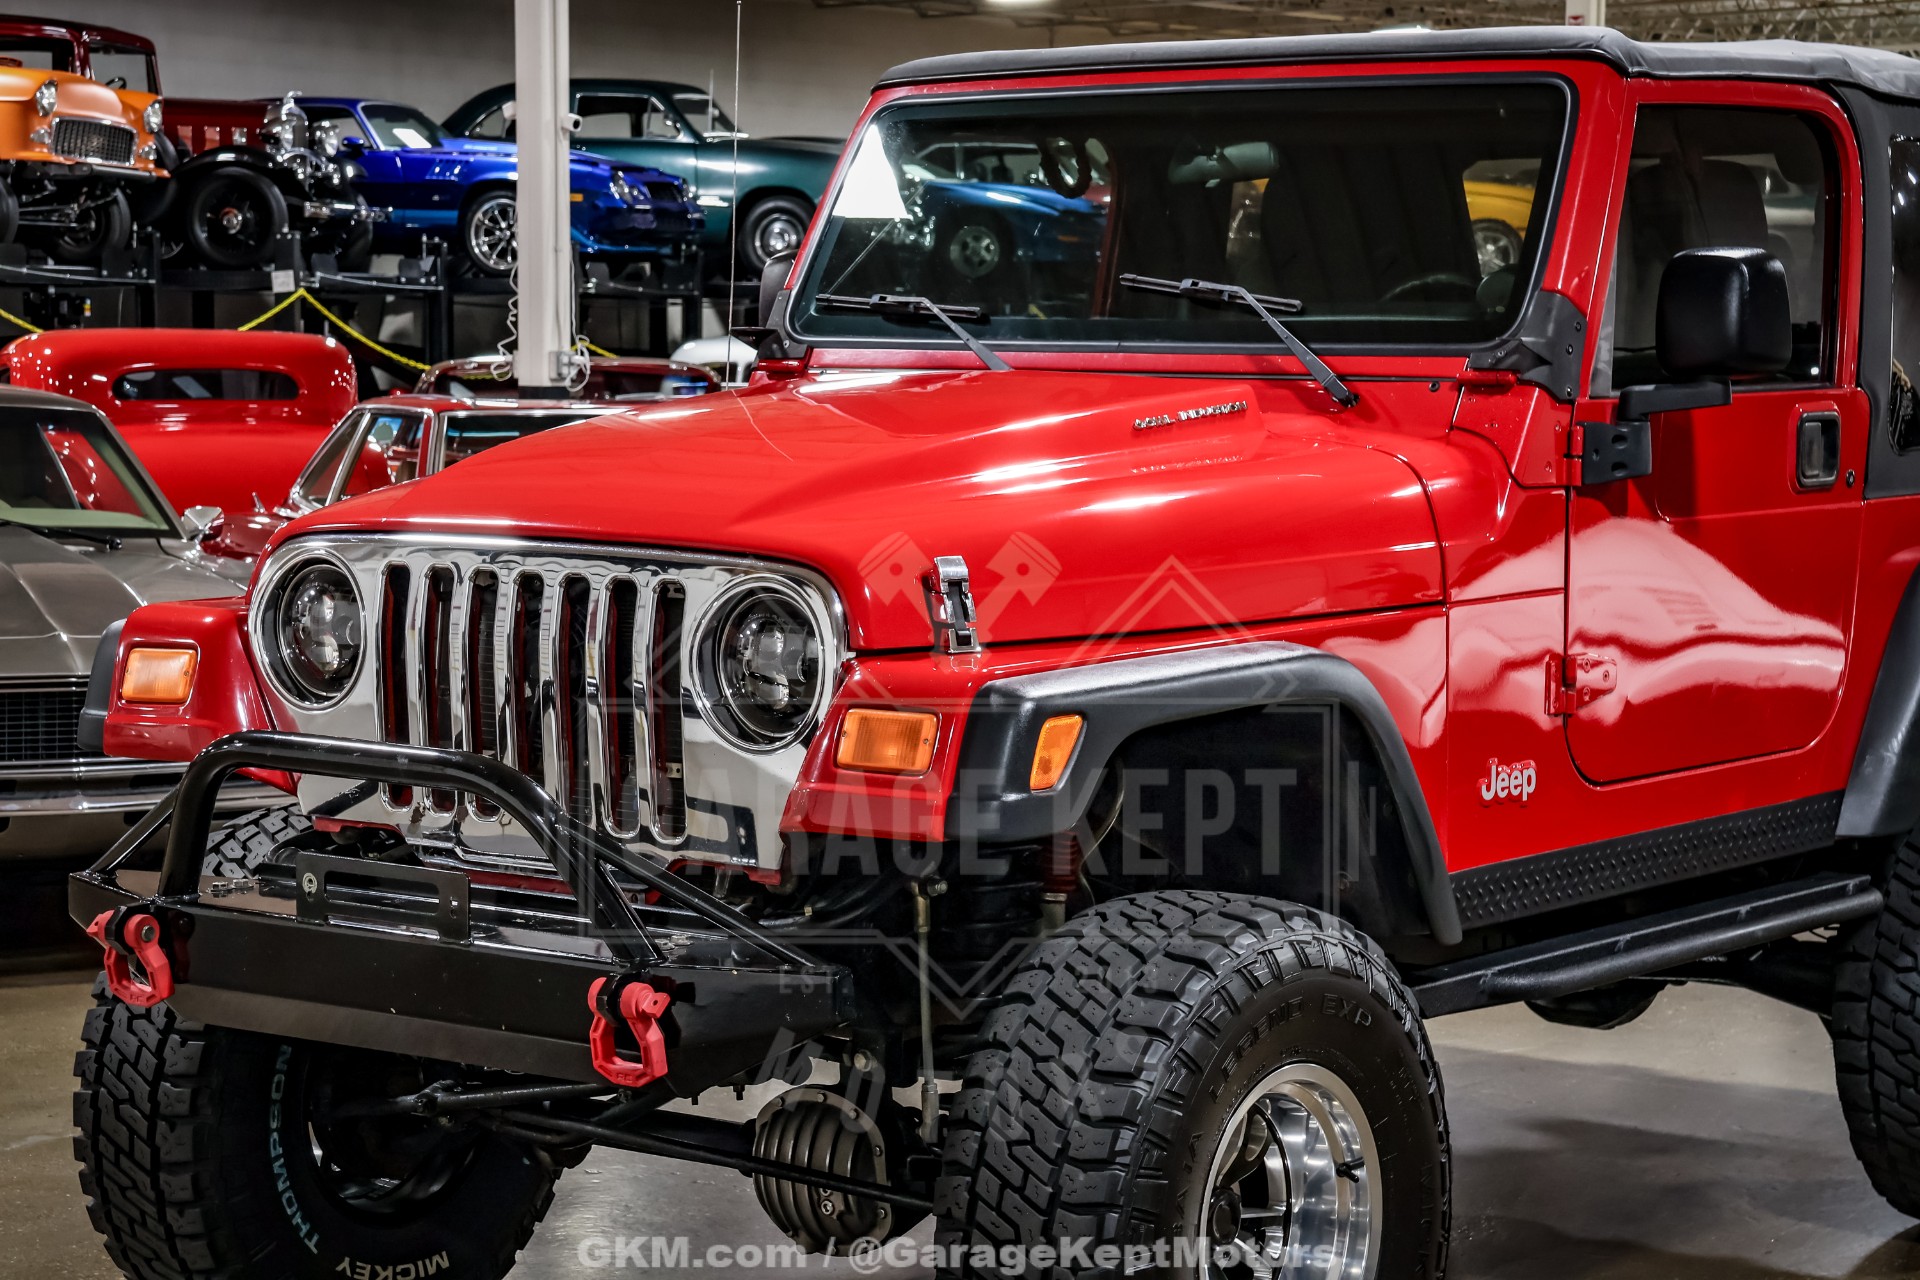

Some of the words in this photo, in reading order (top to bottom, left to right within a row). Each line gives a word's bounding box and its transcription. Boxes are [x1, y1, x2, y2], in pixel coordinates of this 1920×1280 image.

[1479, 758, 1537, 802] Jeep
[1321, 993, 1373, 1028] EXP
[269, 1044, 320, 1255] THOMPSON
[335, 1249, 451, 1280] MICKEY
